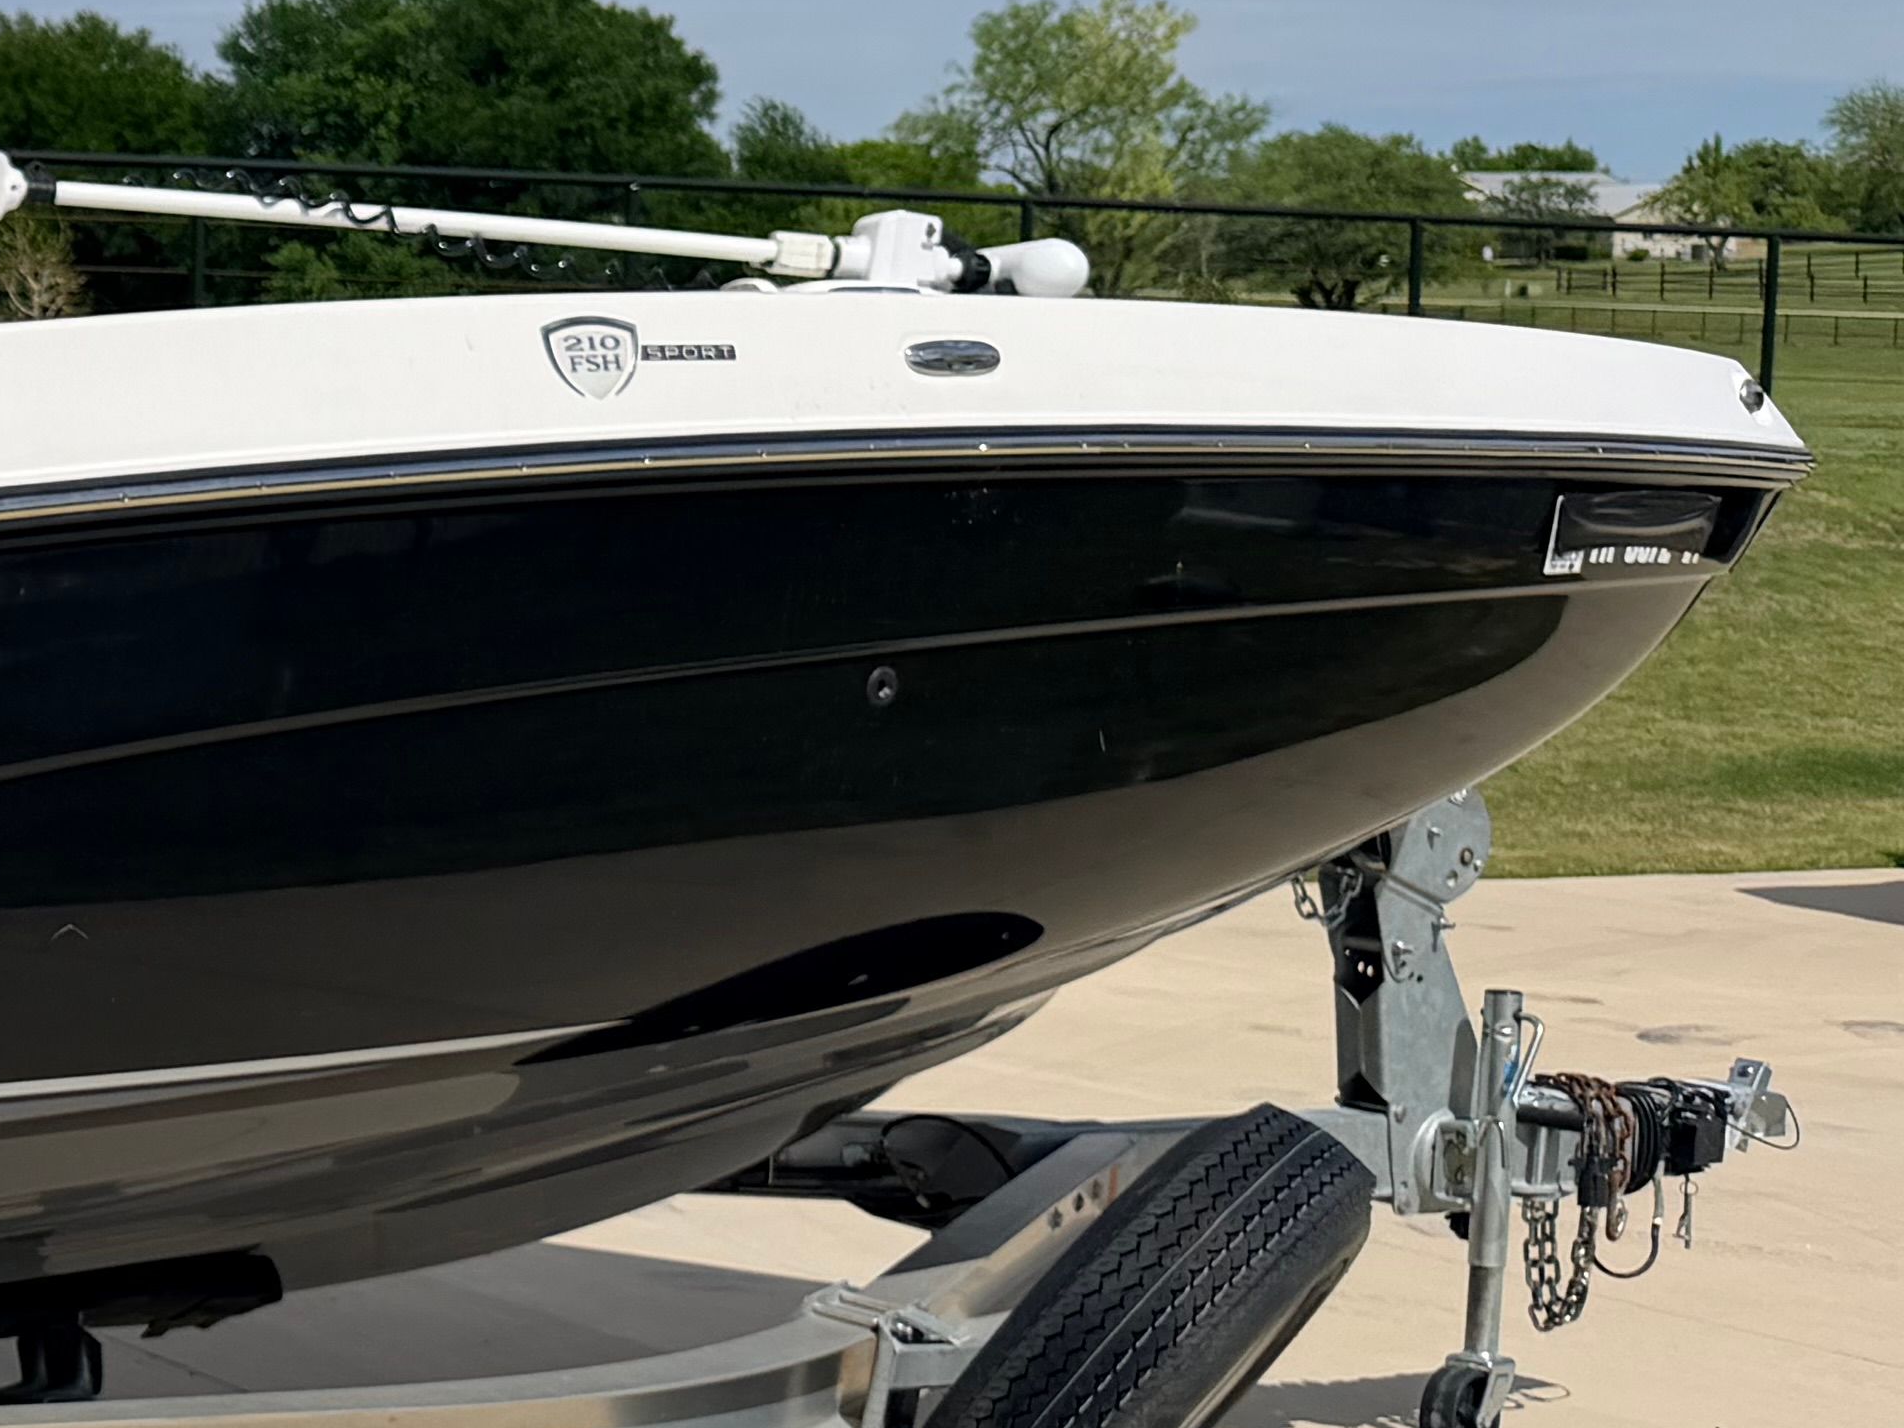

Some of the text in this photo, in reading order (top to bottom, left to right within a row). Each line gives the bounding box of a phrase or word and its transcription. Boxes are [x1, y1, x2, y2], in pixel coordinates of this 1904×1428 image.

[562, 334, 621, 352] 210
[646, 345, 733, 361] SPORT
[568, 354, 622, 373] FSH
